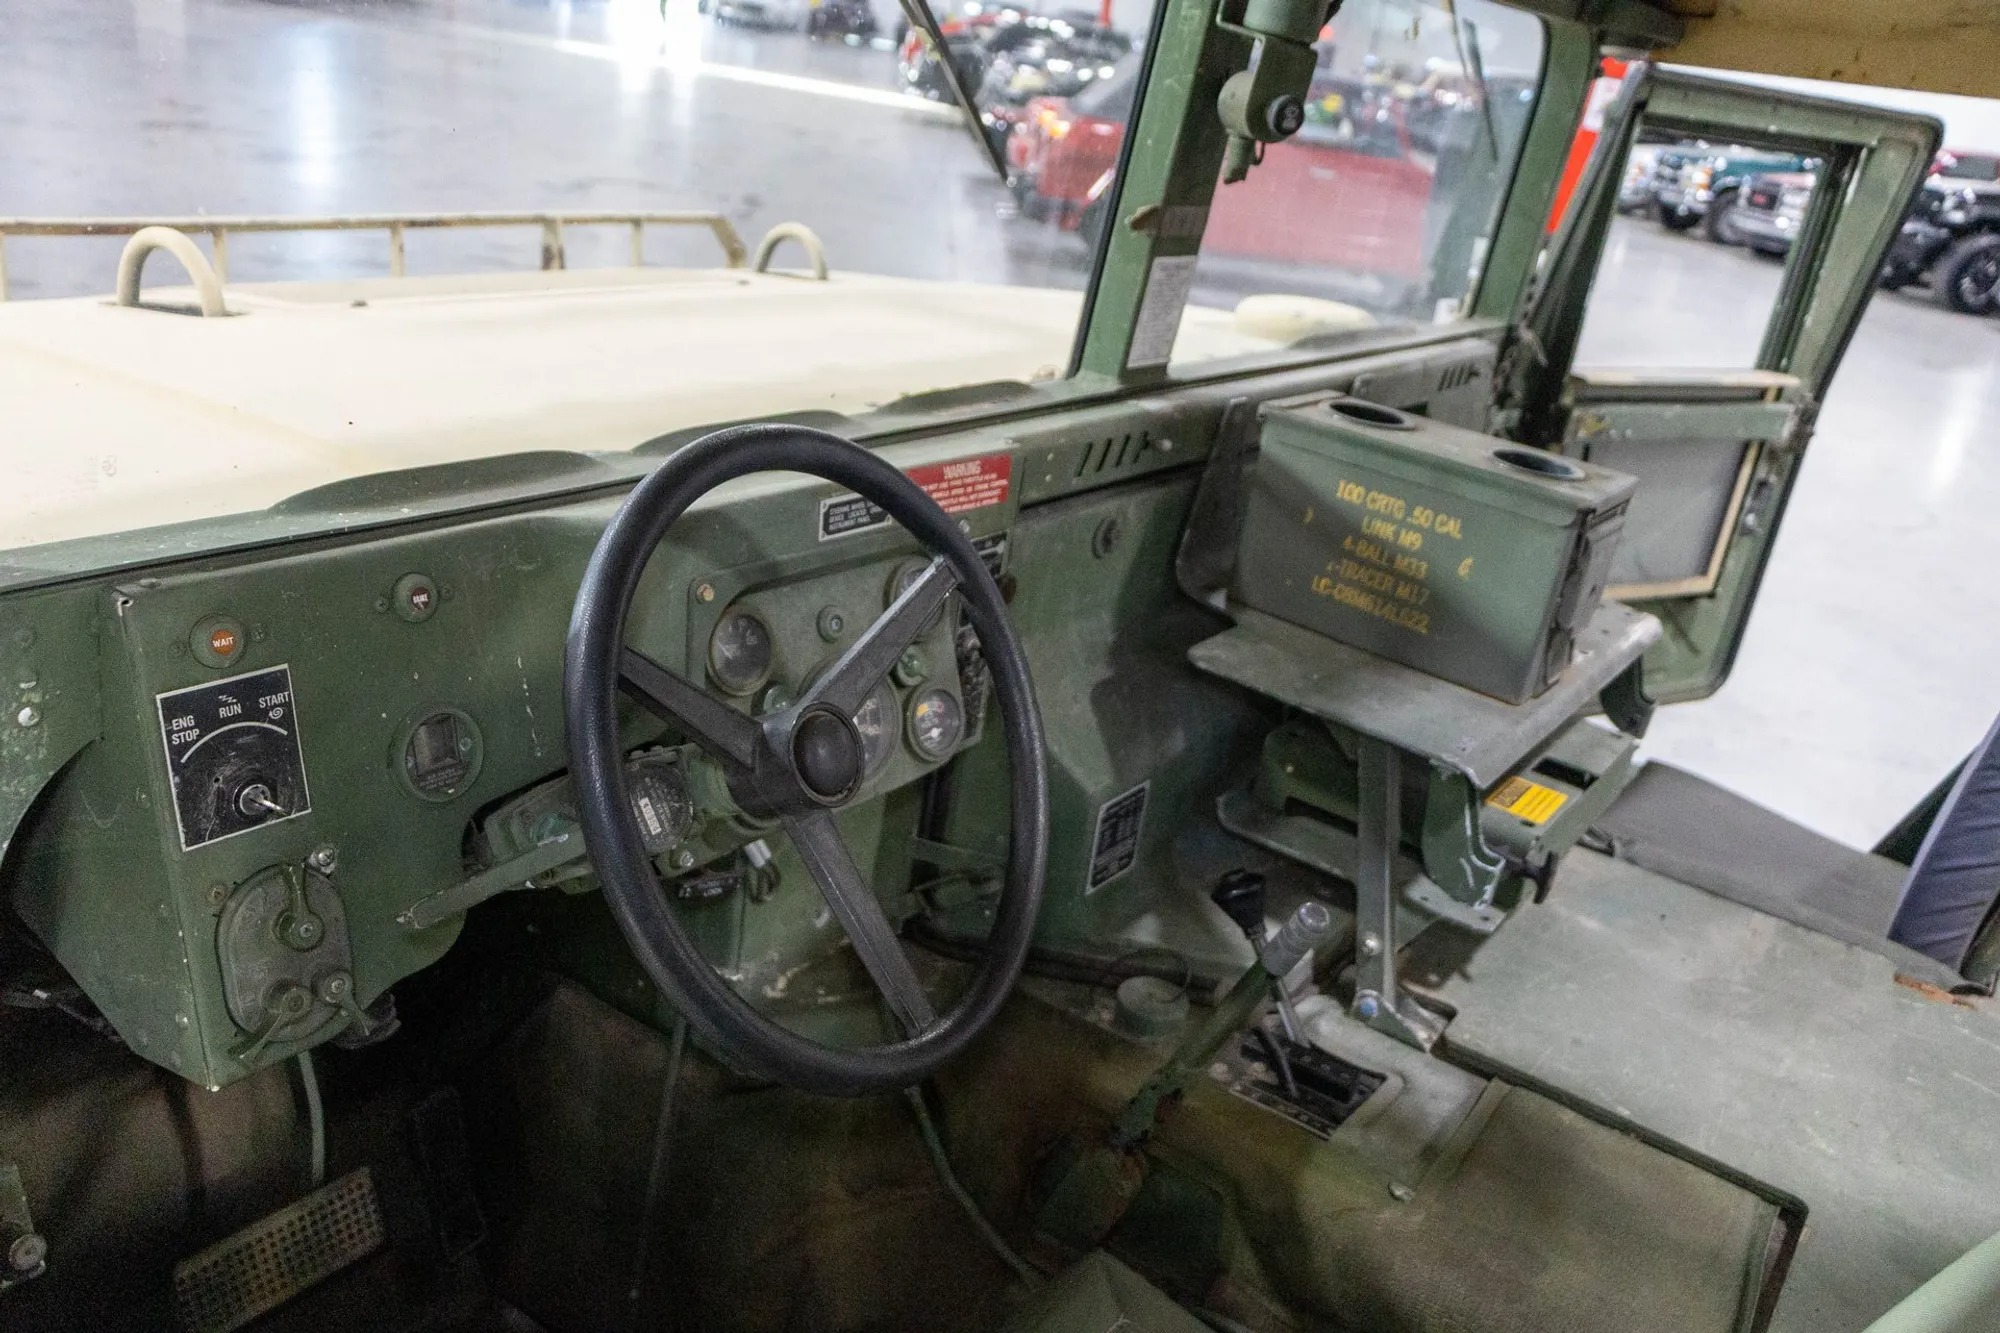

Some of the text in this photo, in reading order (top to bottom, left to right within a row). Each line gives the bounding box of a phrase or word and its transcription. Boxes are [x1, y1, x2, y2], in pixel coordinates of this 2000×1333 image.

[1336, 479, 1366, 505] 100
[1434, 513, 1463, 540] CAL
[1361, 515, 1424, 551] LINK M9
[212, 636, 235, 648] WAIT
[259, 691, 290, 709] START
[219, 703, 242, 719] RUN
[172, 715, 195, 731] ENG
[171, 728, 200, 746] STOP
